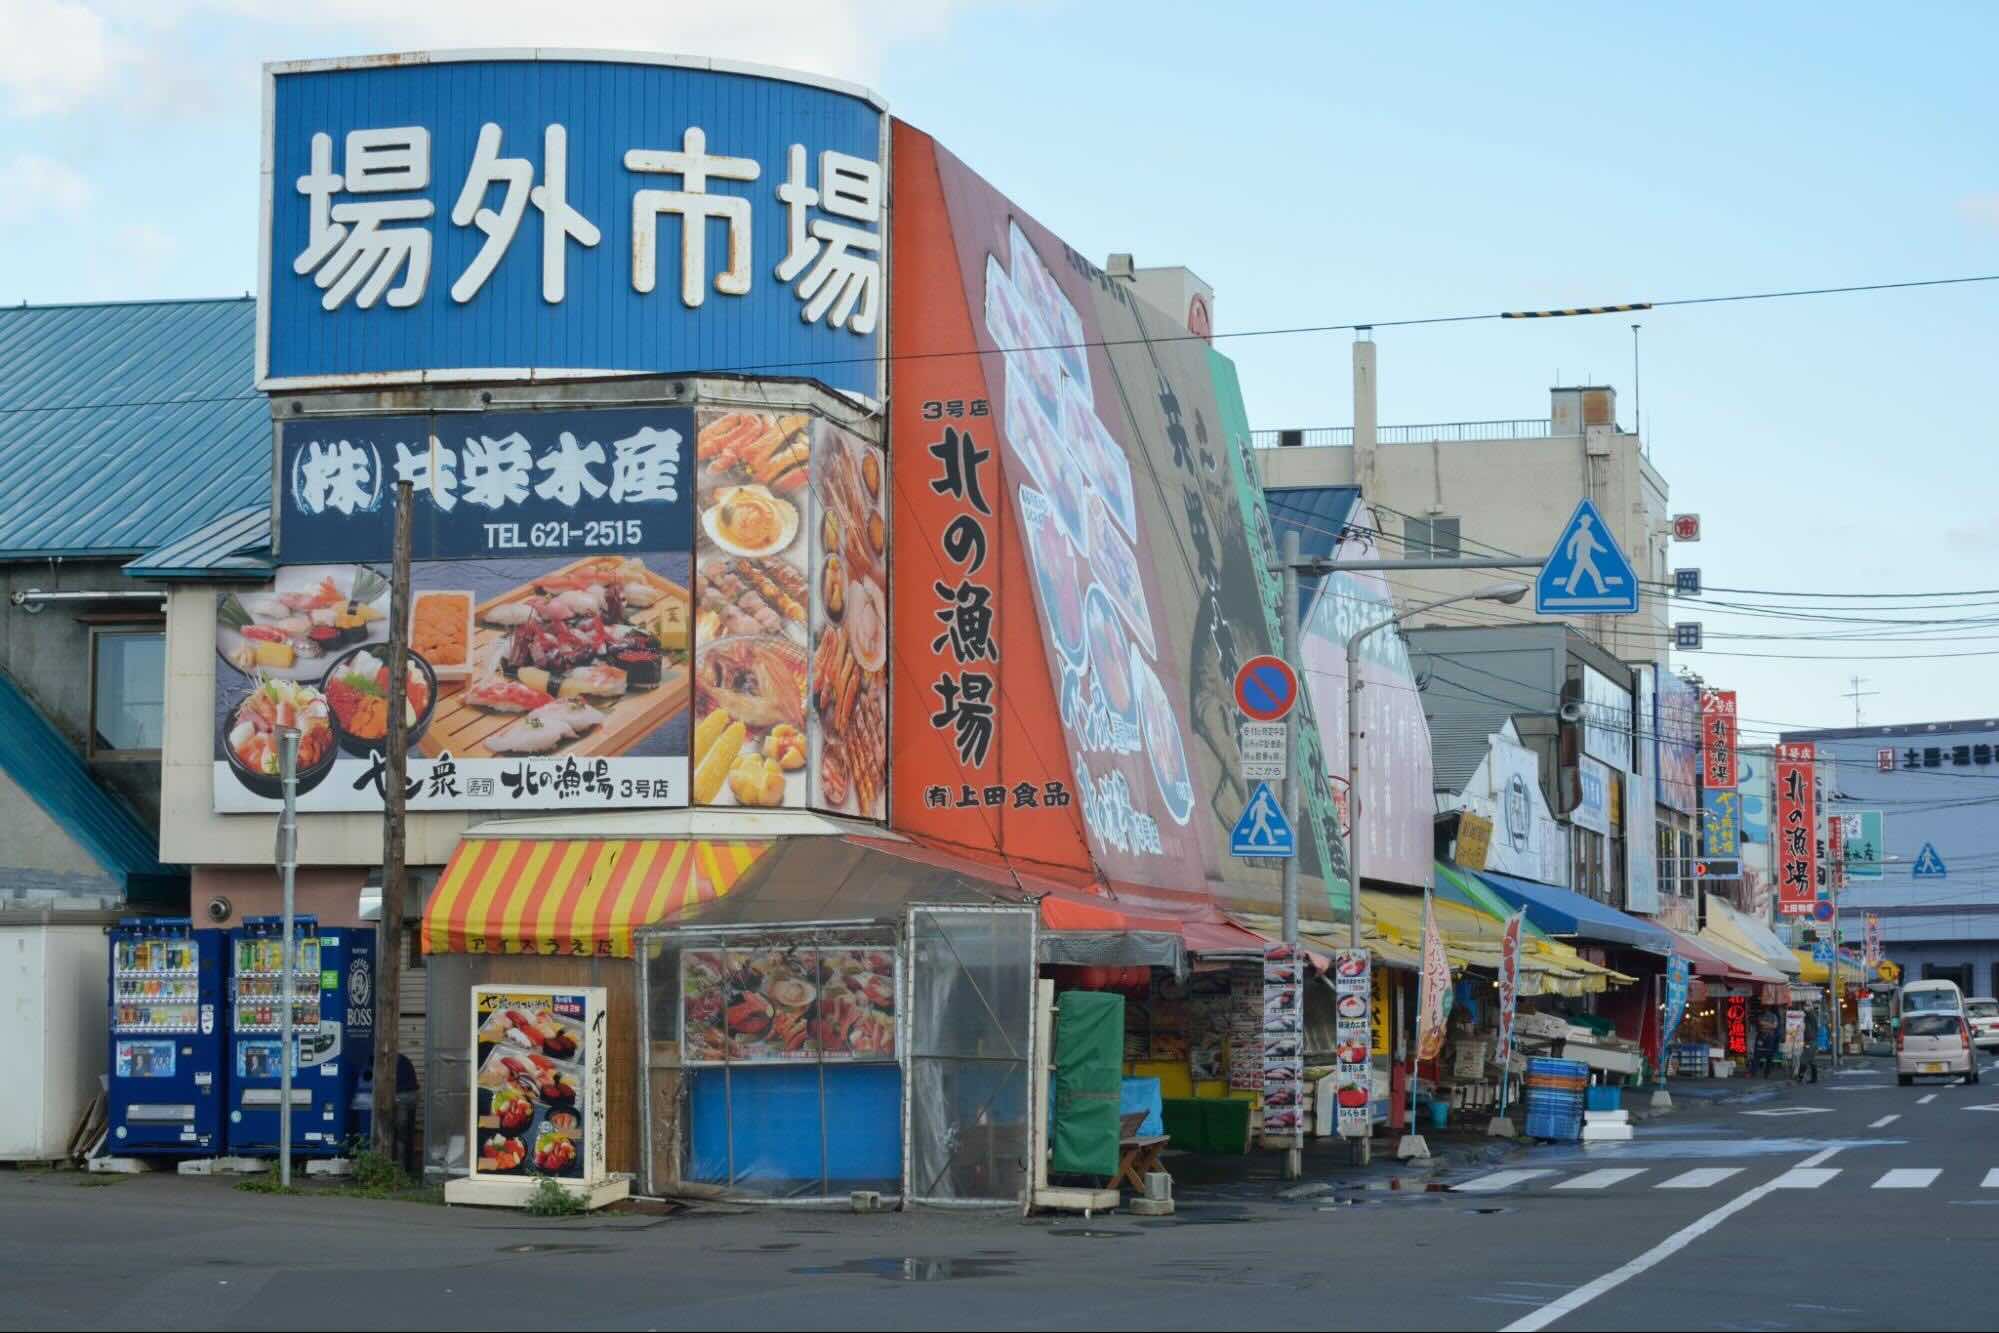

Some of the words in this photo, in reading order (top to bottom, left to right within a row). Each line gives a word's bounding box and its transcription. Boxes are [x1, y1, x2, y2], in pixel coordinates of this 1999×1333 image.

[293, 121, 882, 336] 場外市場
[922, 400, 990, 420] 3号店
[484, 522, 527, 548] TEL
[532, 519, 642, 548] 621-2515
[926, 427, 998, 766] 北の漁場
[1703, 694, 1734, 713] 2号店
[501, 757, 614, 799] 北の漁場
[620, 779, 668, 798] 3号店
[1785, 768, 1809, 896] 北の漁場
[347, 1008, 372, 1026] BOSS
